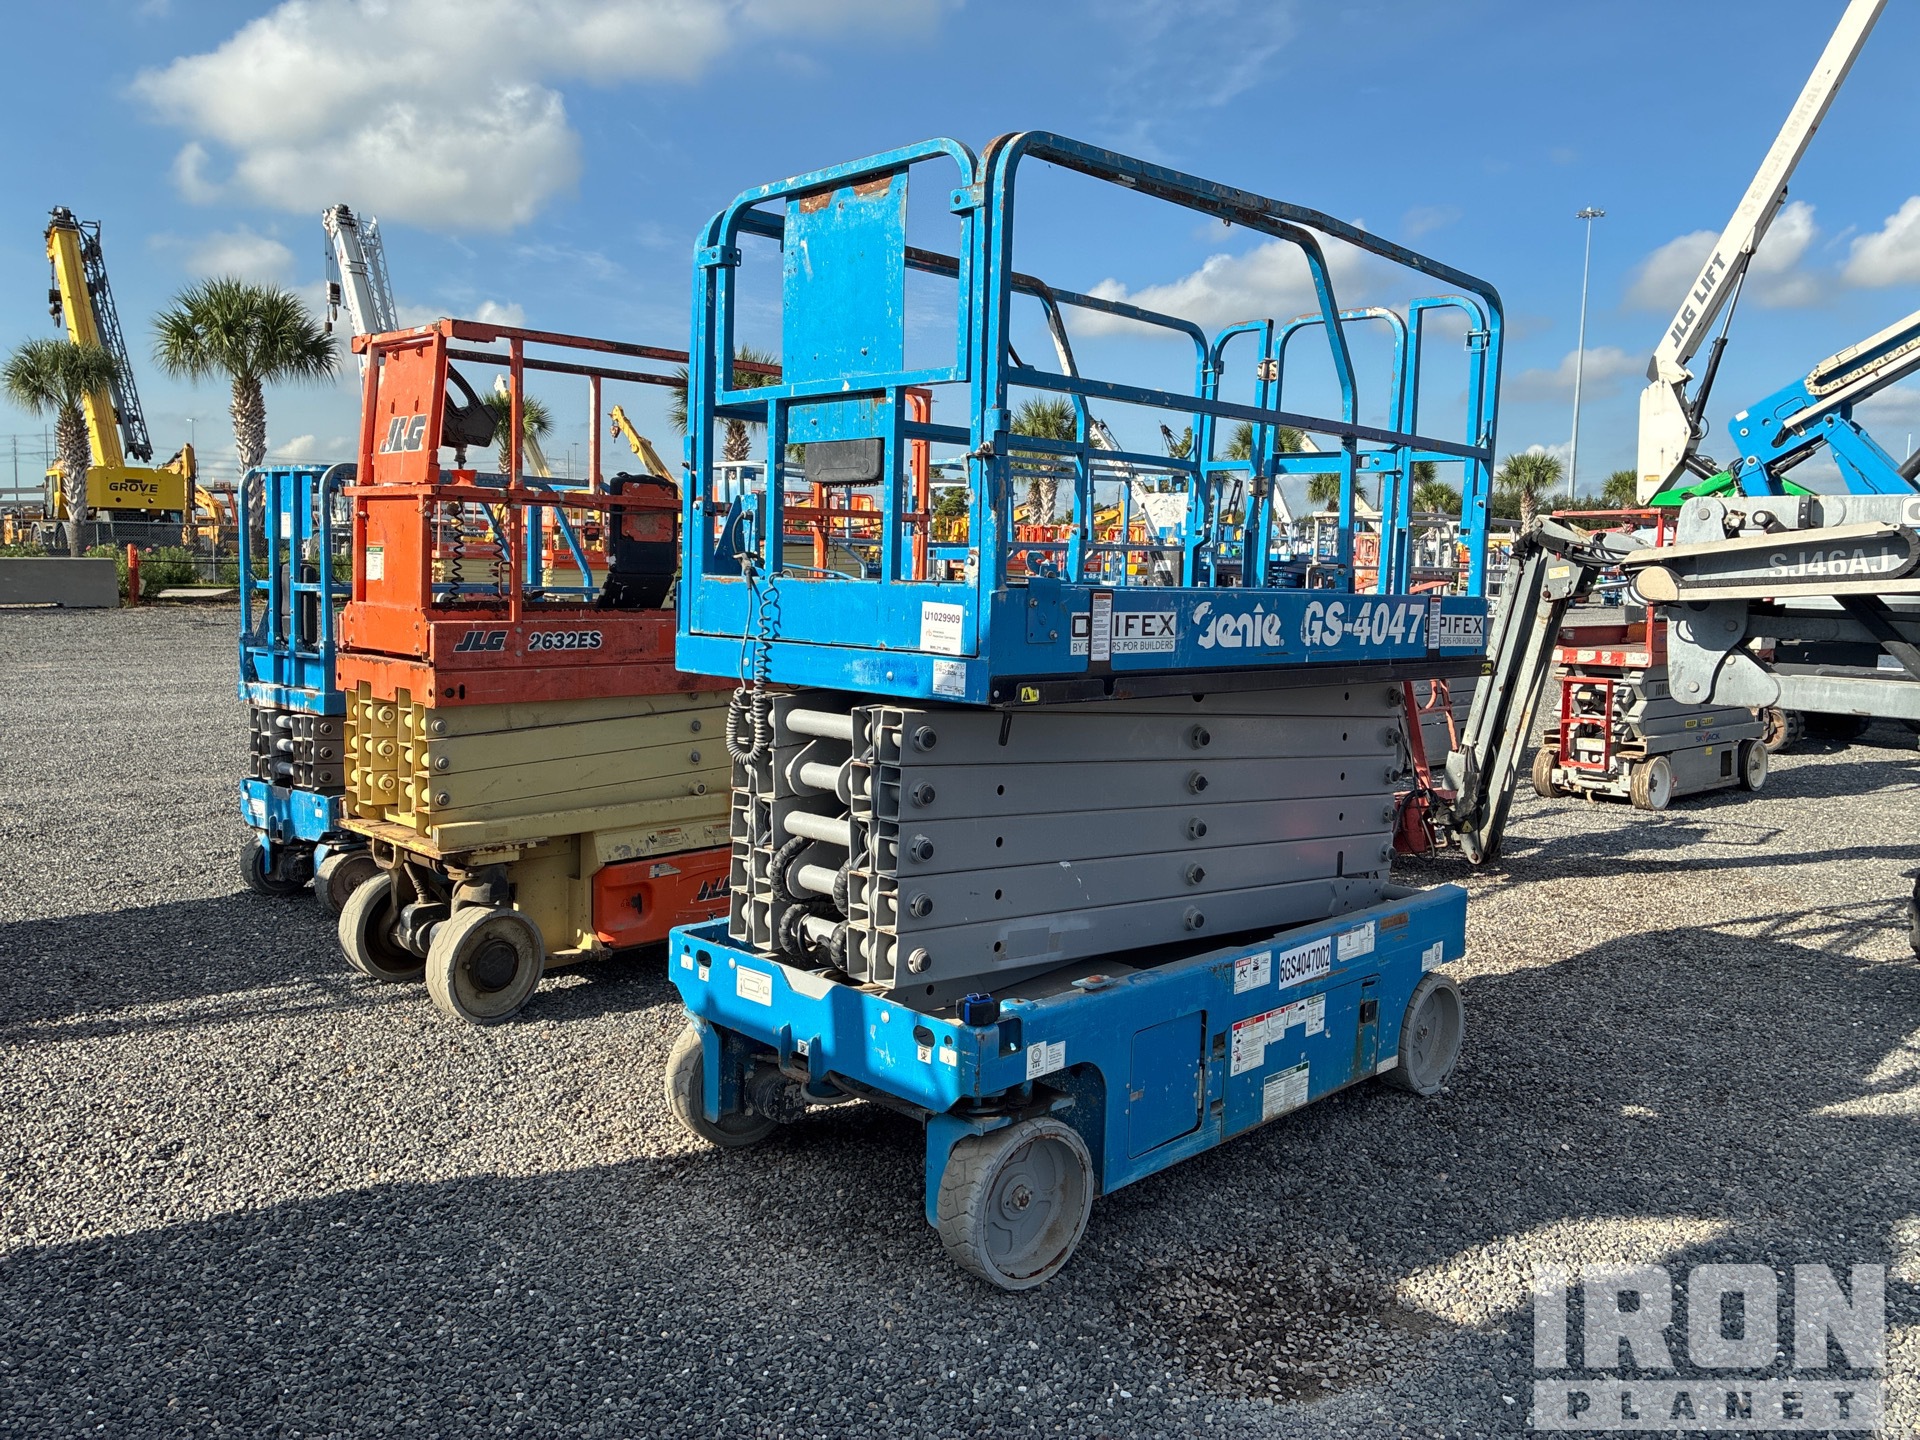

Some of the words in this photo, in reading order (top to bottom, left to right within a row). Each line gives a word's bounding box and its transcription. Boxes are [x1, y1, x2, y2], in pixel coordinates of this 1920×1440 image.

[1670, 304, 1697, 349] JLG
[1693, 252, 1726, 305] LIFT
[378, 414, 427, 454] JLG
[109, 482, 159, 493] GROVE
[1769, 547, 1889, 577] SJ46AJ
[924, 610, 961, 624] U1029909
[1072, 615, 1175, 637] OIFEX
[1192, 601, 1284, 649] Genie
[1301, 601, 1425, 647] GS-4047
[453, 630, 508, 653] JLG
[528, 631, 603, 651] 2632ES
[1073, 642, 1083, 653] BY
[1123, 641, 1138, 651] FOR
[1140, 640, 1174, 650] BUILDERS
[1280, 944, 1330, 983] 6GS4047002
